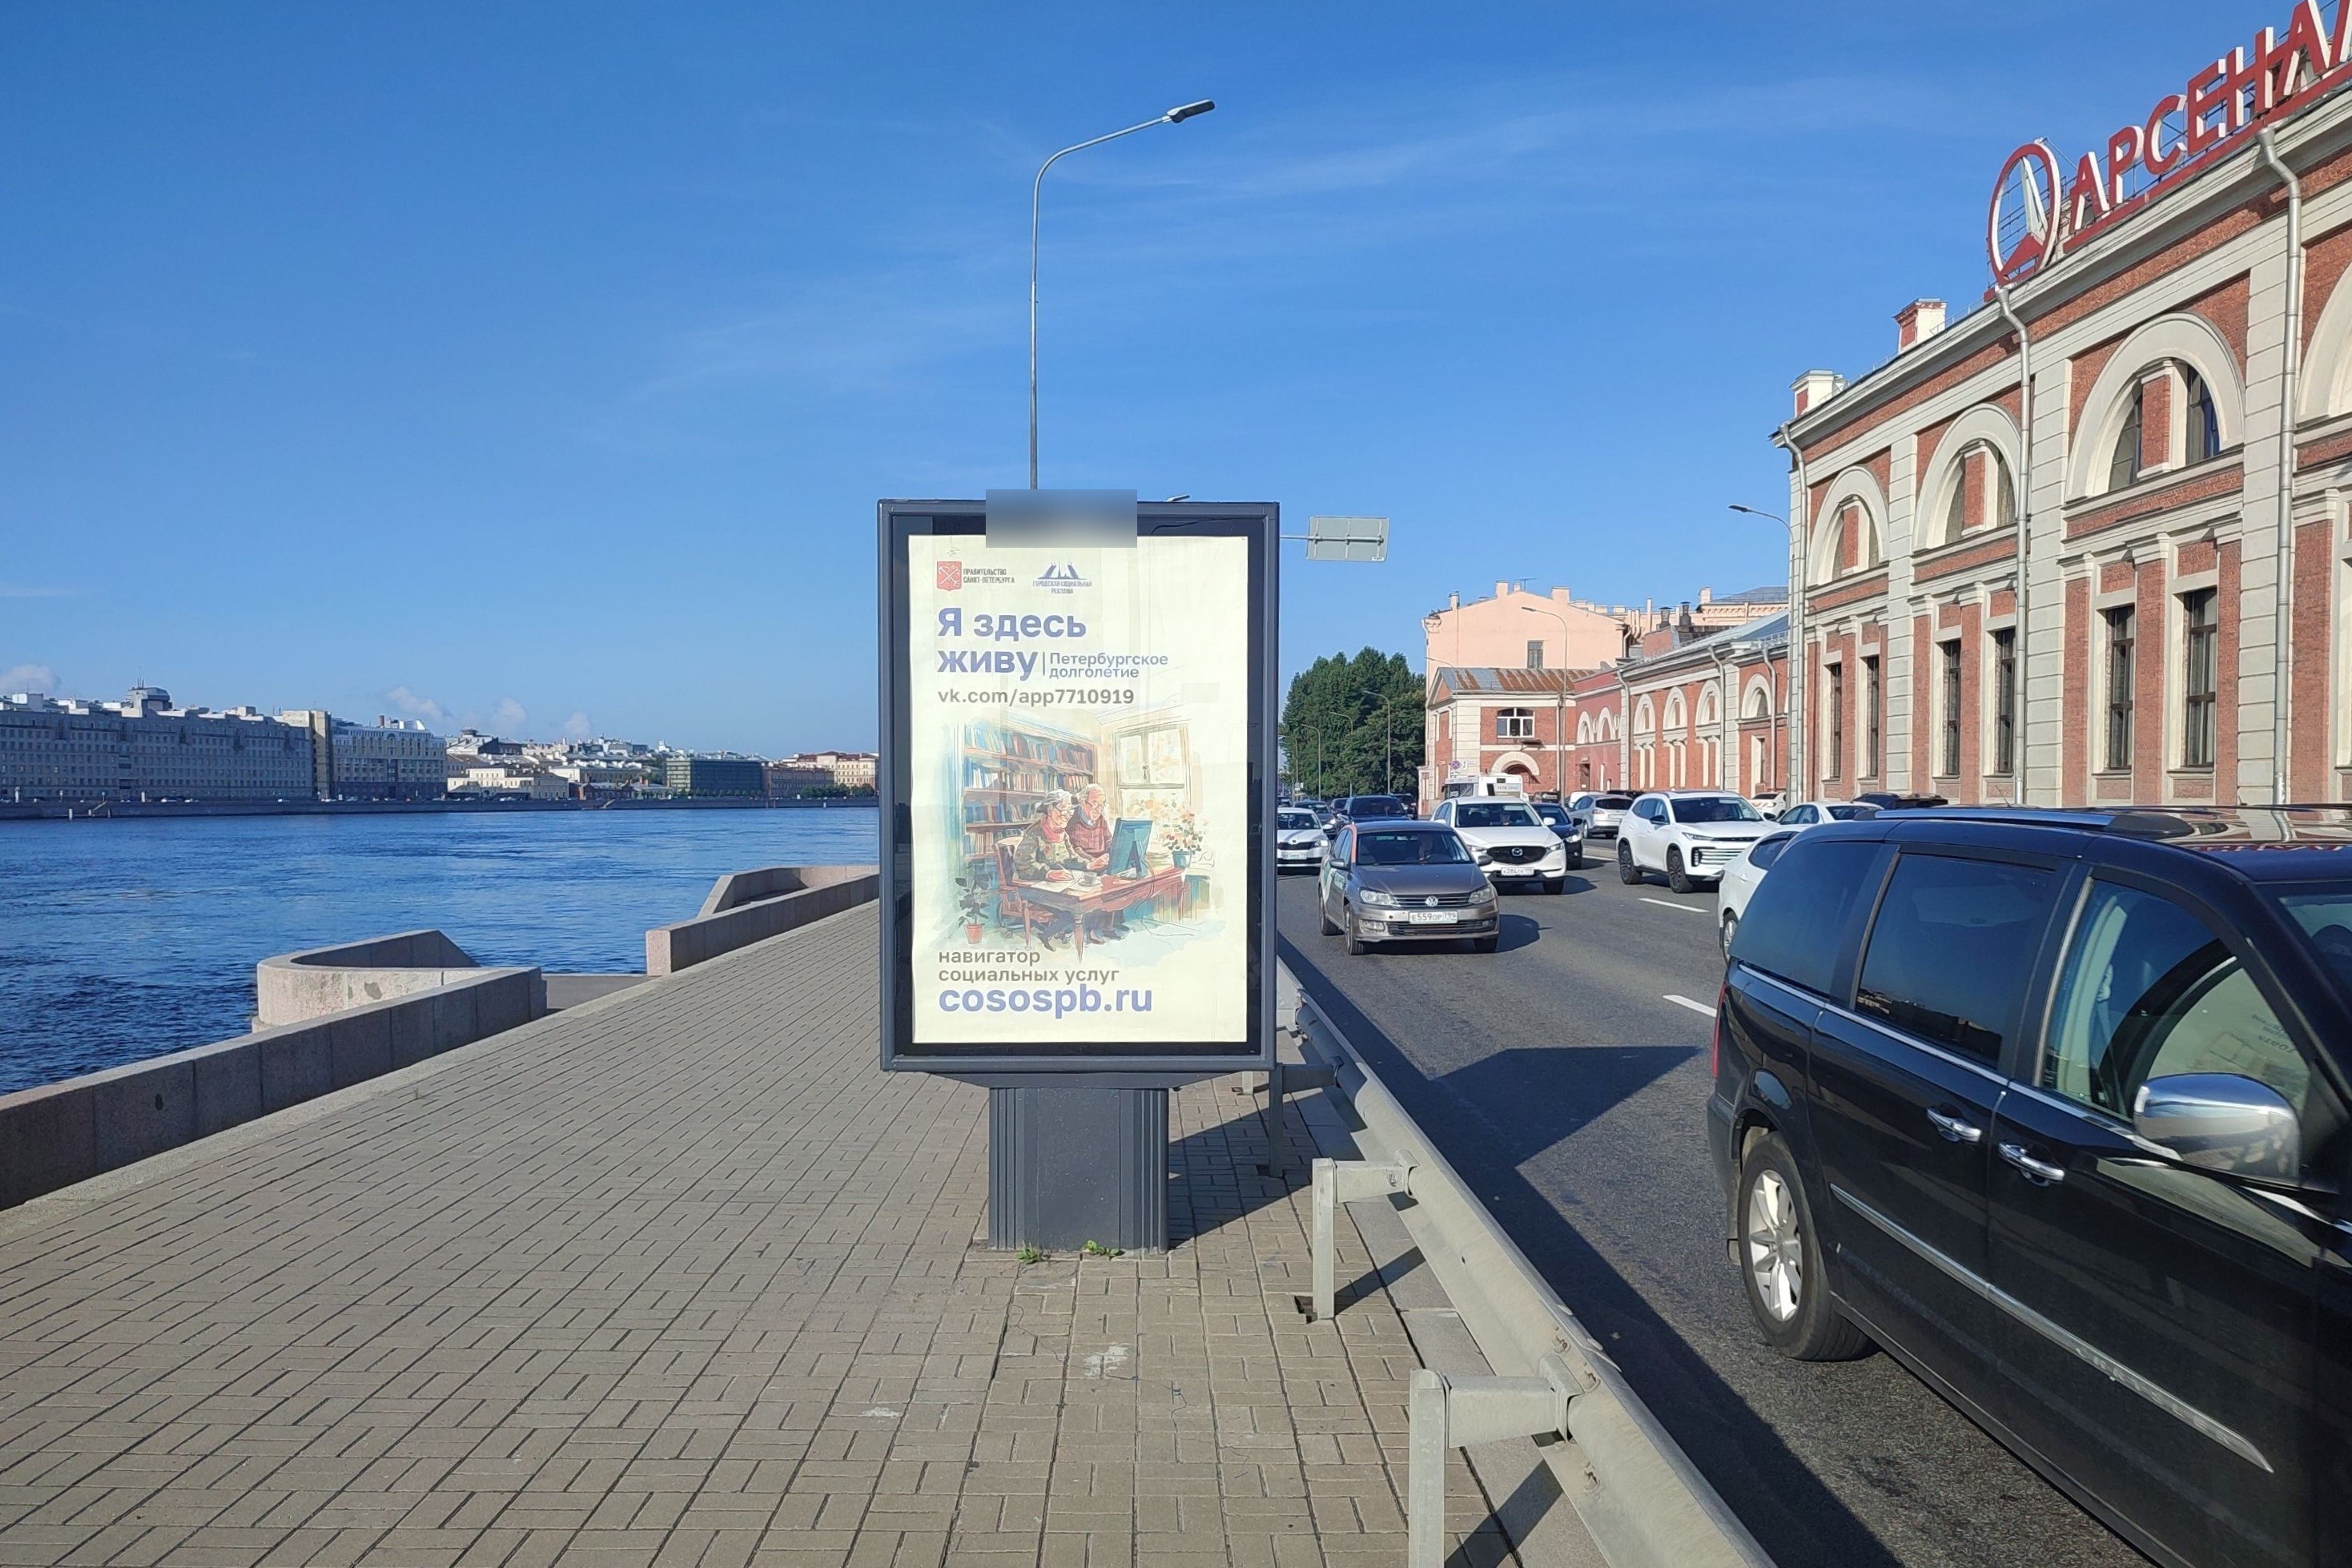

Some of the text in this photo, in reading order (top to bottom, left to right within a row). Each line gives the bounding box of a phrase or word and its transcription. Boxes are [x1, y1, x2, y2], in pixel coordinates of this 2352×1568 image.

[963, 576, 1015, 584] САНКТ-ПЕТЕРБУРГА
[938, 607, 1087, 641] Я здесь
[937, 650, 1038, 680] живу
[1049, 653, 1168, 669] Петербургское
[1049, 666, 1140, 678] долголетие
[938, 689, 1134, 706] vk.com/app7710919
[939, 951, 1040, 967] навигатор
[939, 969, 1120, 985] социальных услуг
[939, 984, 1152, 1019] cosospb.ru
